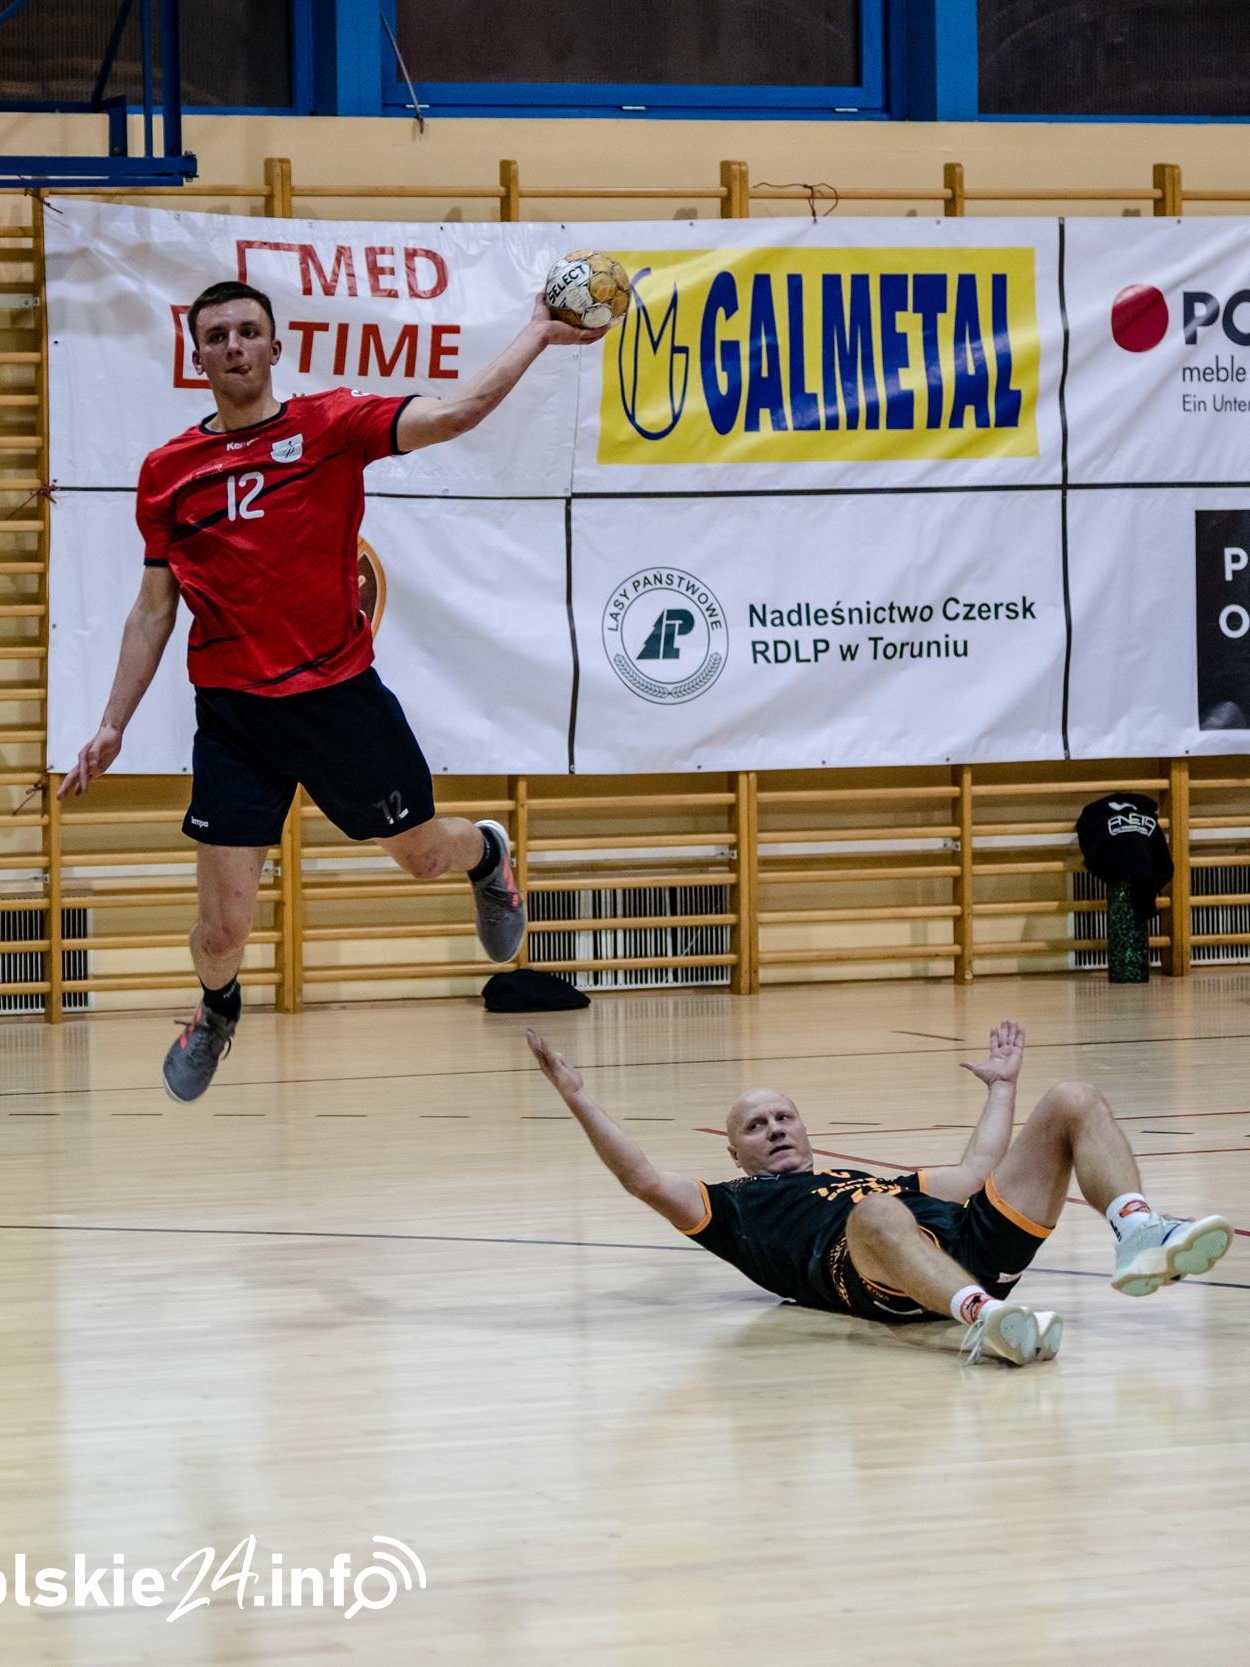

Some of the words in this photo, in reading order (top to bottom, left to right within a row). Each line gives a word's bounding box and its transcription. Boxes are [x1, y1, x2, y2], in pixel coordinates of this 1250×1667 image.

[298, 244, 448, 299] MED
[549, 264, 586, 304] SELECT
[288, 320, 460, 379] TIME
[700, 271, 1021, 435] GALMETAL
[1182, 354, 1247, 382] meble
[1182, 394, 1207, 412] Ein
[227, 471, 265, 521] 12
[1224, 547, 1249, 581] P
[607, 589, 630, 632] LASY
[632, 571, 722, 631] PAŃSTWOWE
[749, 601, 933, 628] Nadleśnictwo
[942, 596, 1036, 621] Czersk
[751, 638, 830, 664] RDLP
[839, 643, 859, 661] w
[868, 634, 968, 660] Toruniu
[374, 790, 409, 825] 12
